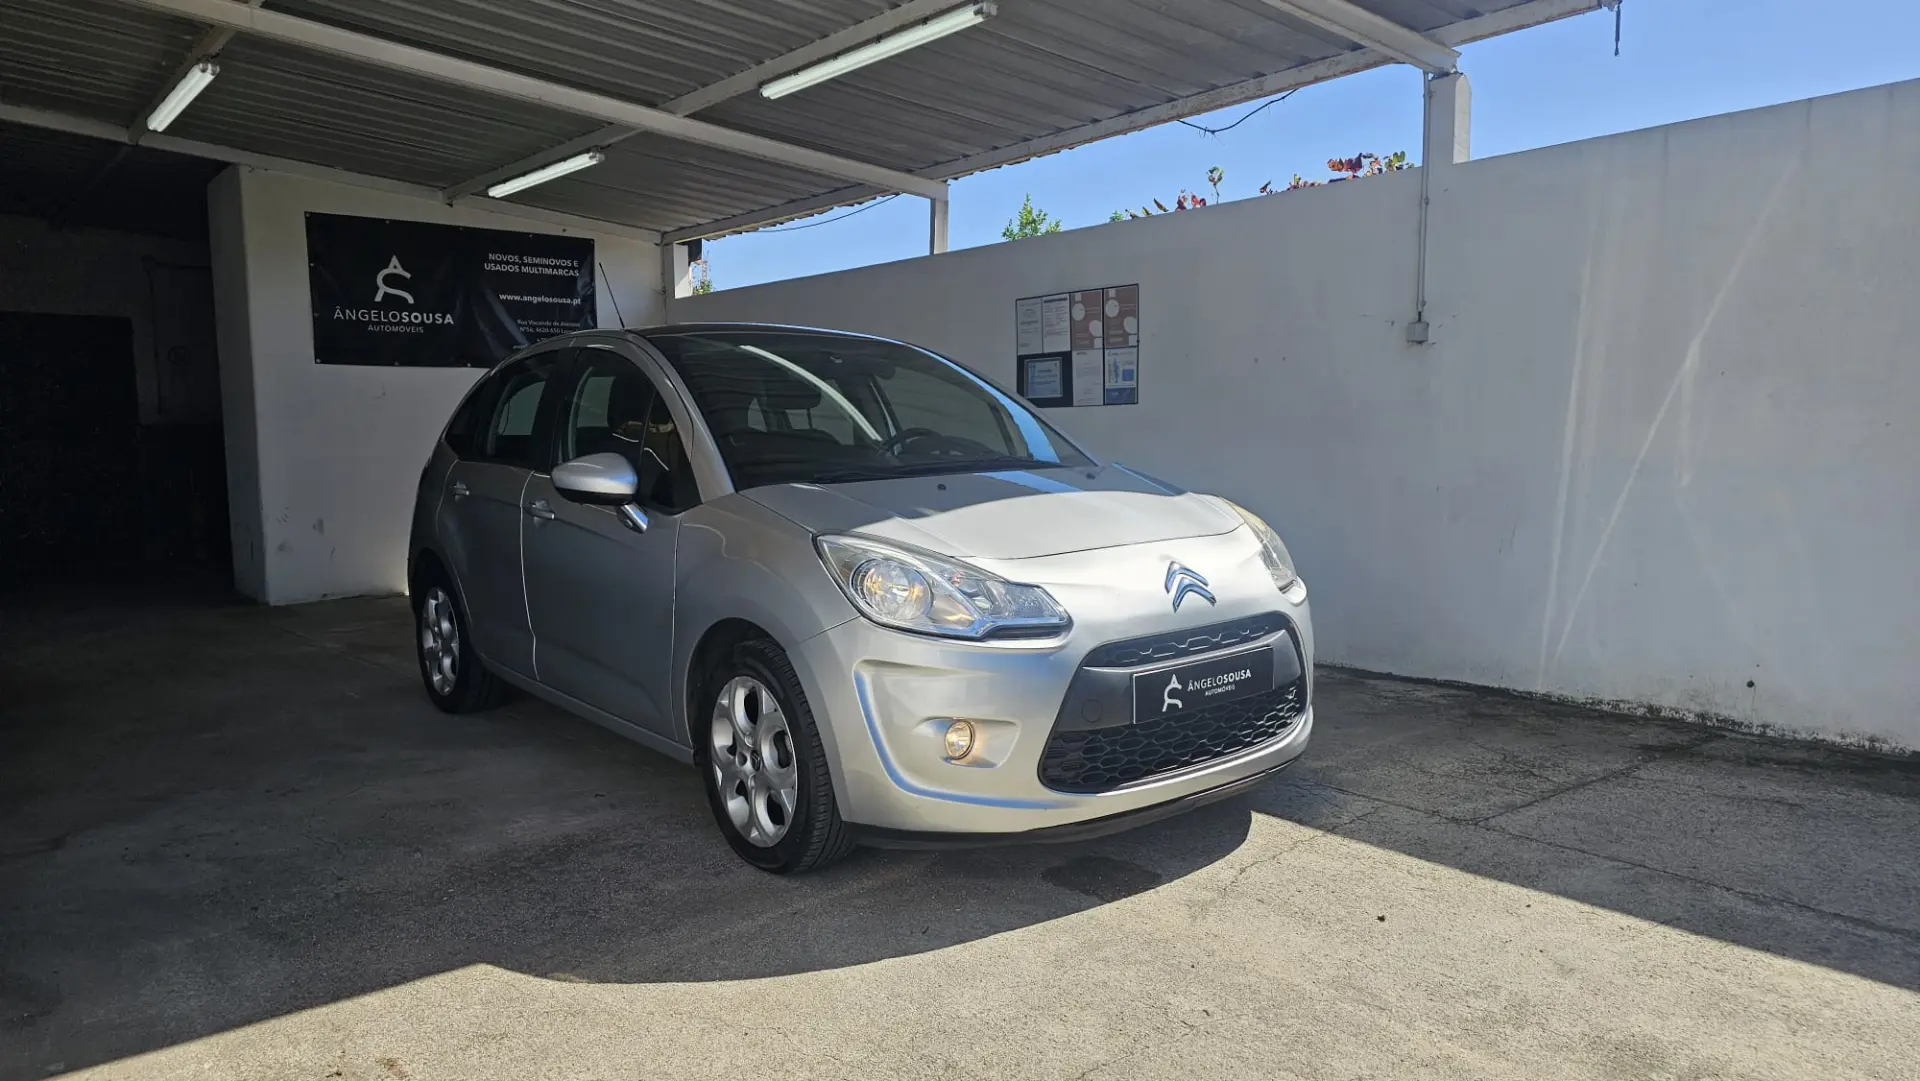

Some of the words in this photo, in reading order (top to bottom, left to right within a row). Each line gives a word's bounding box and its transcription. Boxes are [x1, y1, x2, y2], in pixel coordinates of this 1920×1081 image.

[488, 253, 521, 264] NOVOS,
[523, 255, 572, 267] SEMINOVOS
[484, 263, 520, 273] USADOS
[521, 266, 580, 277] MULTIMARCAS
[499, 293, 581, 306] www.angelosousa.pt
